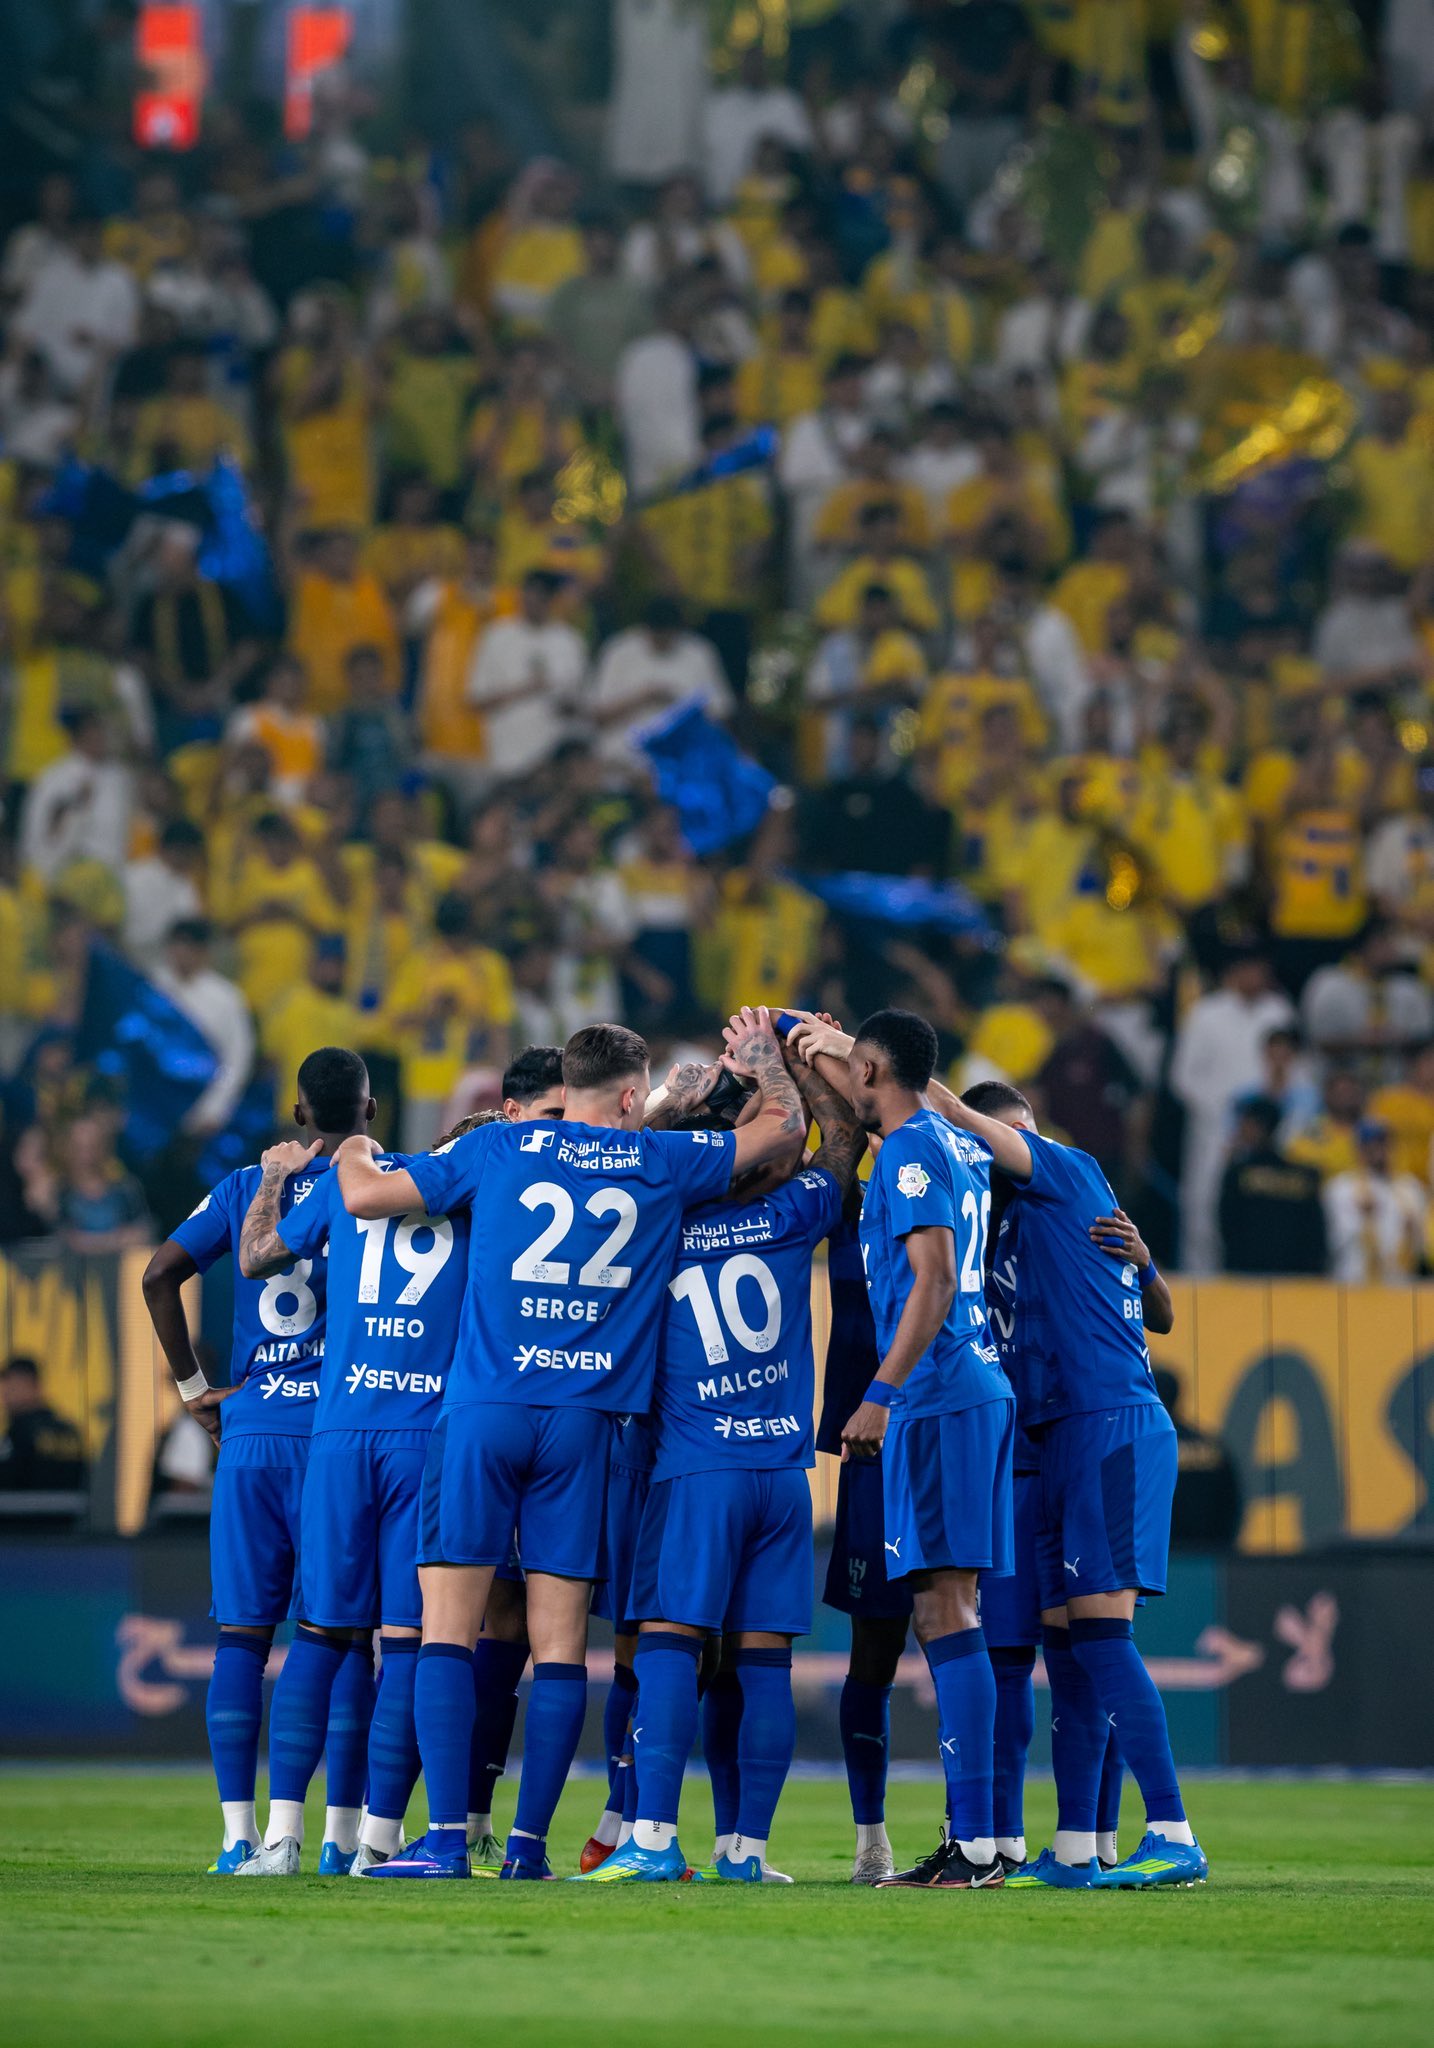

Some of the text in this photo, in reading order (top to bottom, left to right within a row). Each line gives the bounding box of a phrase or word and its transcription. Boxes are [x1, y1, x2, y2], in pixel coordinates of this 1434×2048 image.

[557, 1147, 642, 1170] Riyad Bank
[511, 1181, 638, 1288] 22
[683, 1230, 773, 1251] Riyad Bank
[355, 1217, 455, 1306] 19
[364, 1317, 425, 1338] THEO
[667, 1253, 782, 1366] 10
[697, 1359, 789, 1401] MALCOM
